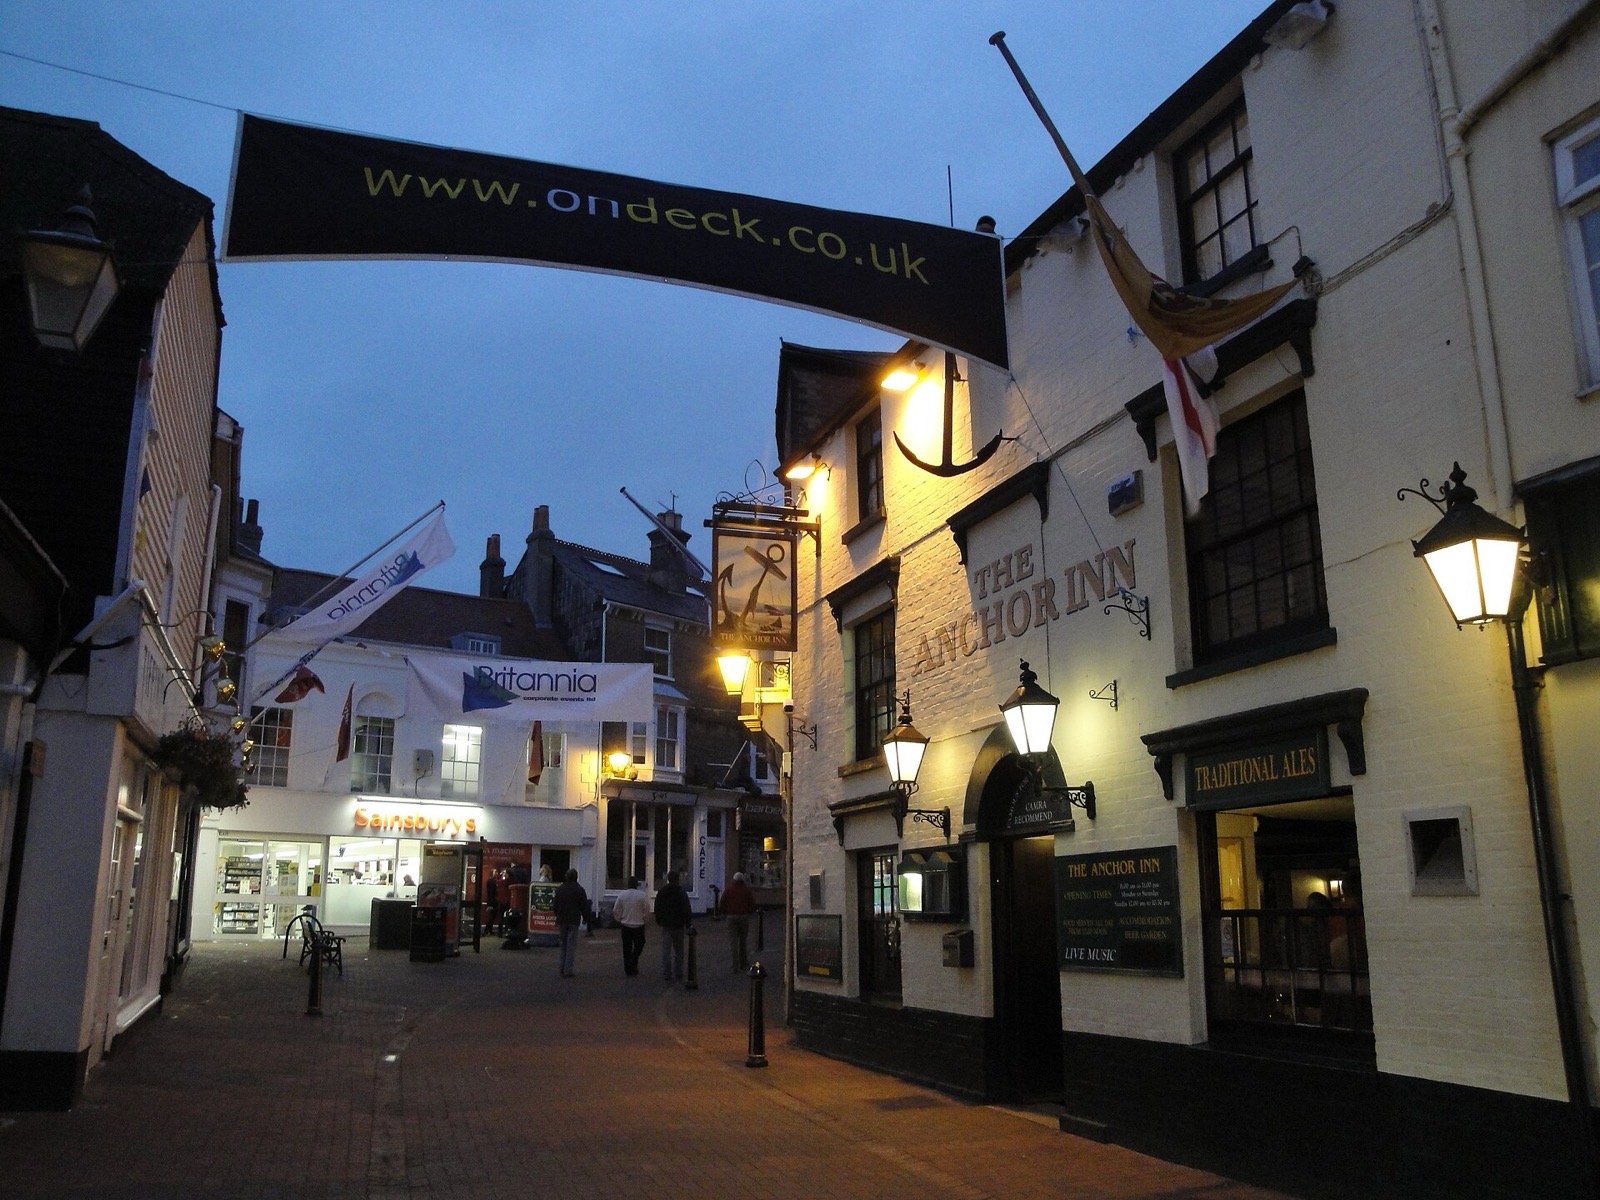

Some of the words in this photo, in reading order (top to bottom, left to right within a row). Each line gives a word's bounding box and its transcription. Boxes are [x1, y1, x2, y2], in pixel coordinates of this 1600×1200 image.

[363, 165, 930, 287] www.ondeck.co.uk
[974, 543, 1034, 600] THE
[911, 577, 1060, 677] ANCHOR
[1064, 538, 1136, 615] INN
[720, 632, 734, 640] THE
[739, 634, 771, 643] ANCHOR
[772, 636, 788, 644] INN
[479, 665, 597, 693] Britannia
[1195, 754, 1279, 791] TRADITIONAL
[1282, 747, 1316, 778] ALES
[1014, 811, 1053, 825] RECOMMEND
[1025, 800, 1047, 812] CAMRA
[354, 808, 476, 837] Sainsburys
[1068, 864, 1088, 878] THE
[1091, 860, 1136, 876] ANCHOR
[1140, 858, 1160, 873] INN
[1093, 889, 1112, 900] TIMES
[1065, 947, 1085, 960] LIVE
[1086, 947, 1117, 961] MUSIC
